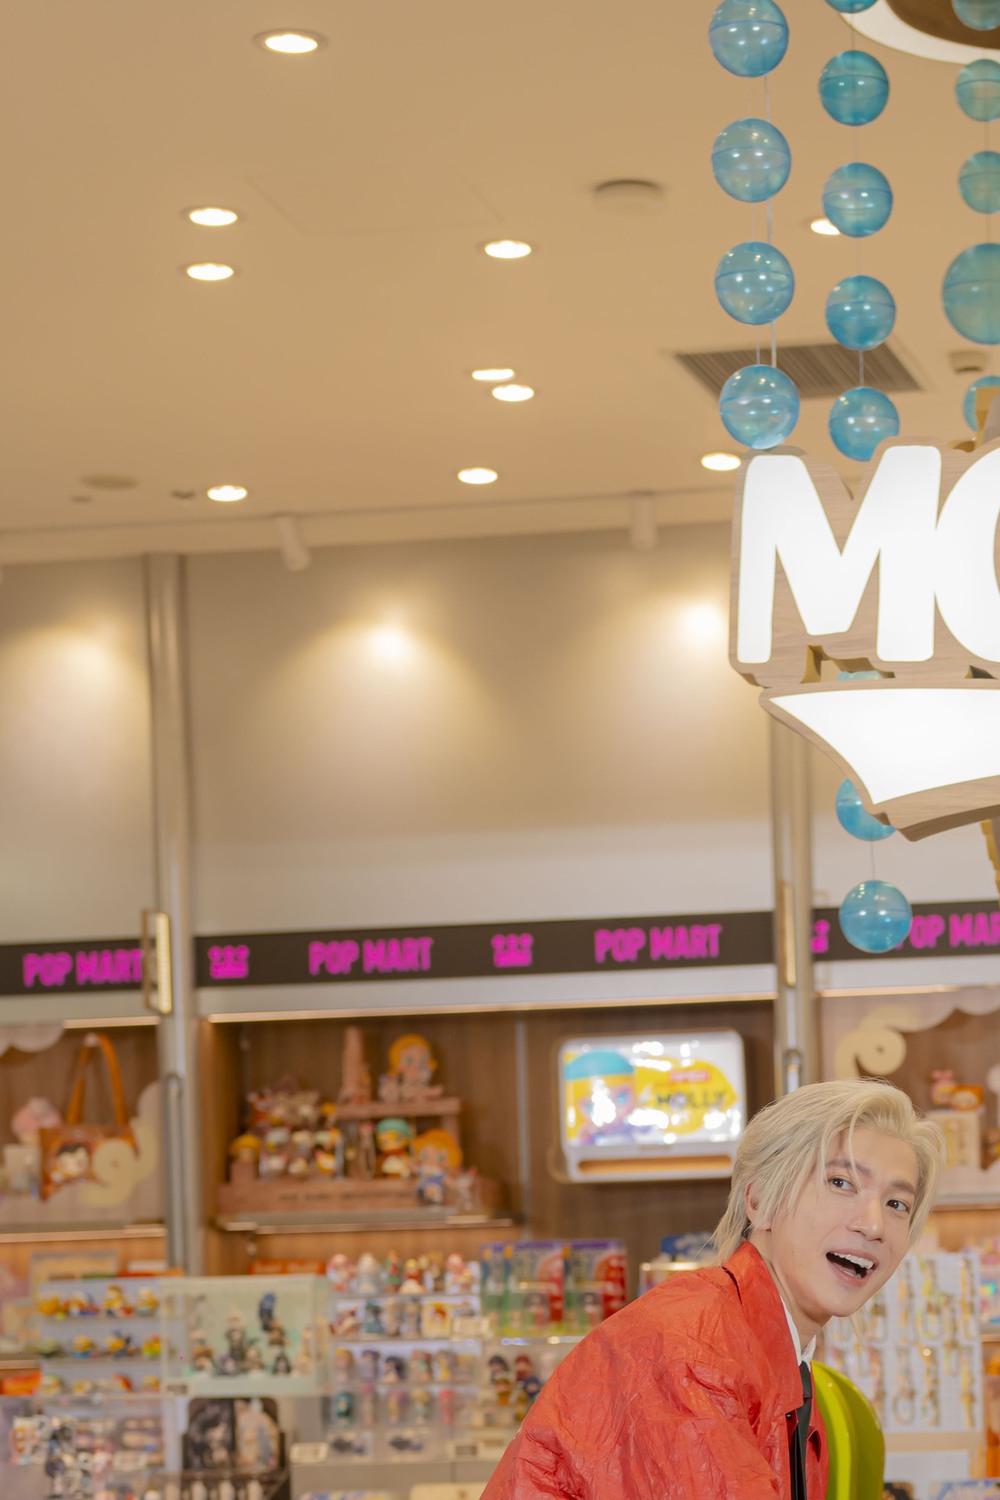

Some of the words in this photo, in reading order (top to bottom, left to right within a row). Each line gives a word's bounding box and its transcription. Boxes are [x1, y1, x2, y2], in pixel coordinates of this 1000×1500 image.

[595, 927, 646, 963] POP
[650, 923, 722, 961] MART
[896, 913, 945, 949] OP
[22, 951, 73, 988] POP
[75, 947, 144, 985] MART
[308, 939, 360, 976] POP
[362, 936, 434, 974] MART
